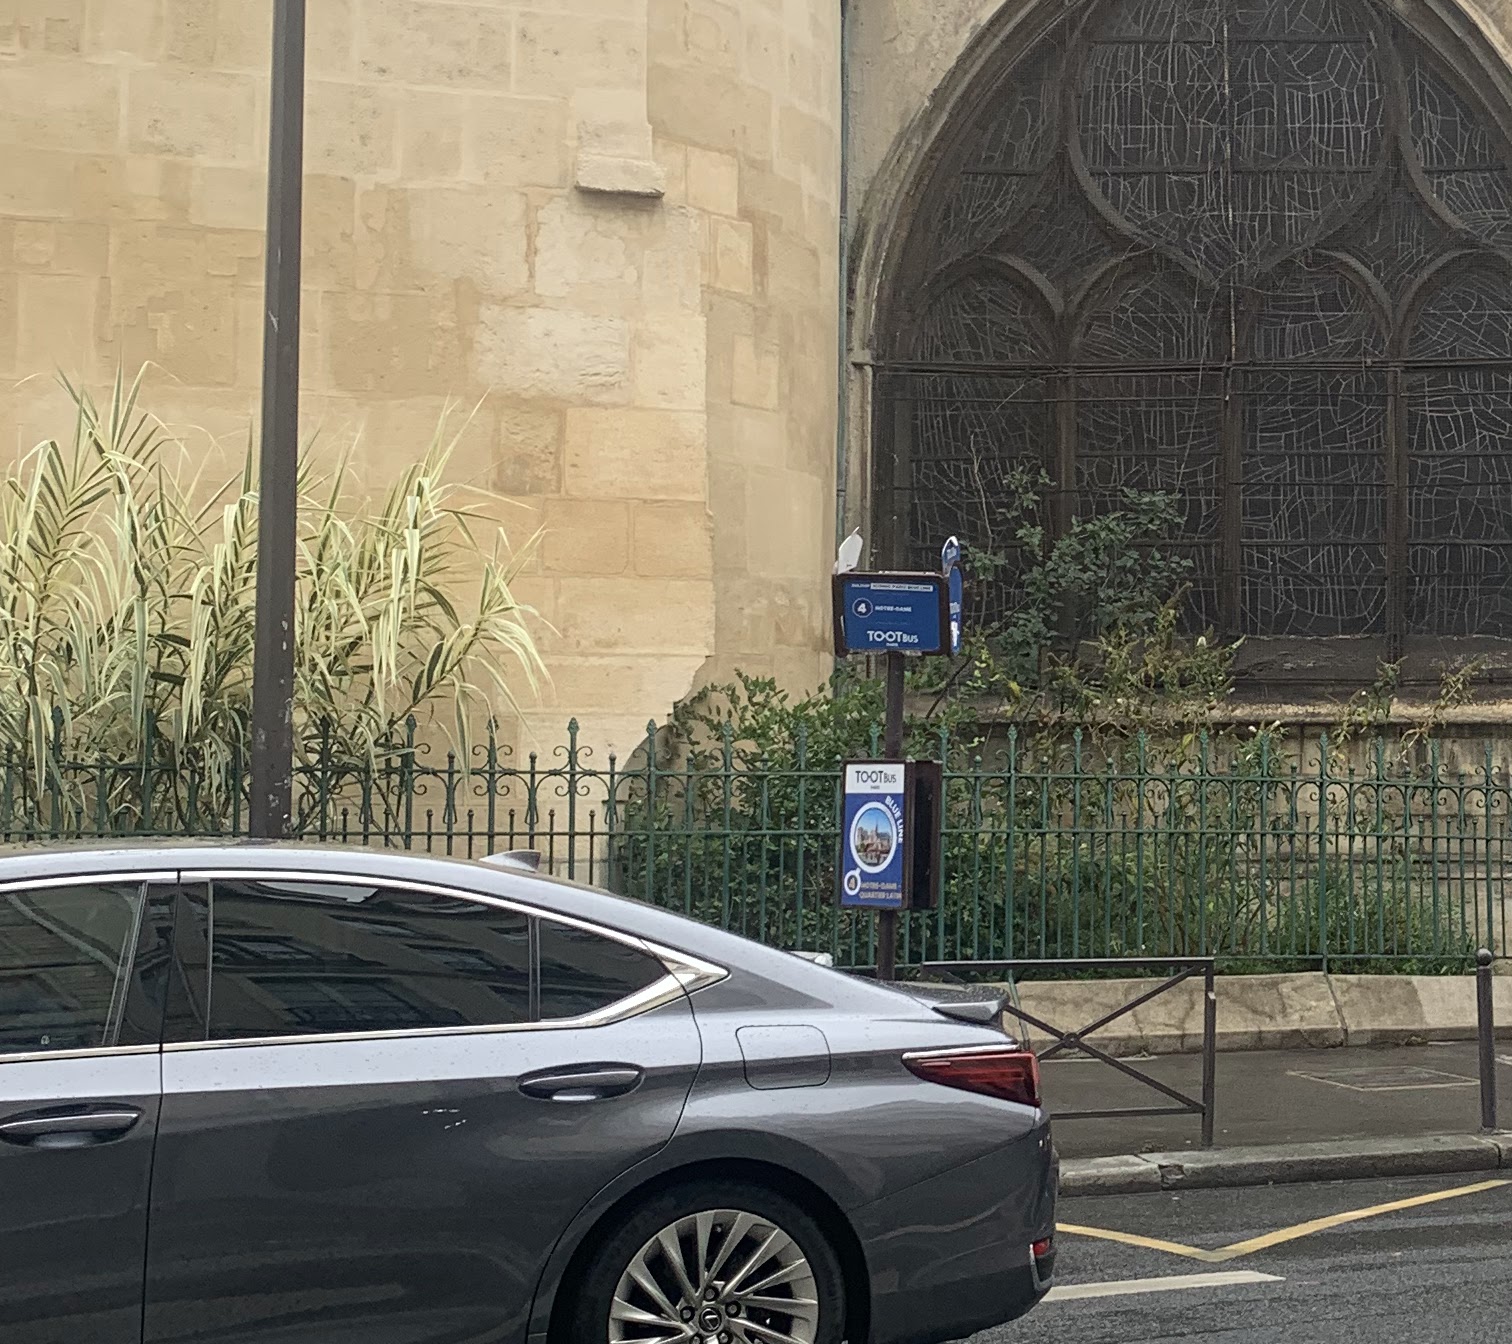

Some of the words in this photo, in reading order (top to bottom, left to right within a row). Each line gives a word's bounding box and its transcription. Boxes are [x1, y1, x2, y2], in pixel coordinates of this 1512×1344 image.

[857, 603, 867, 613] 4
[885, 795, 902, 818] BLUE
[896, 817, 904, 844] LINE
